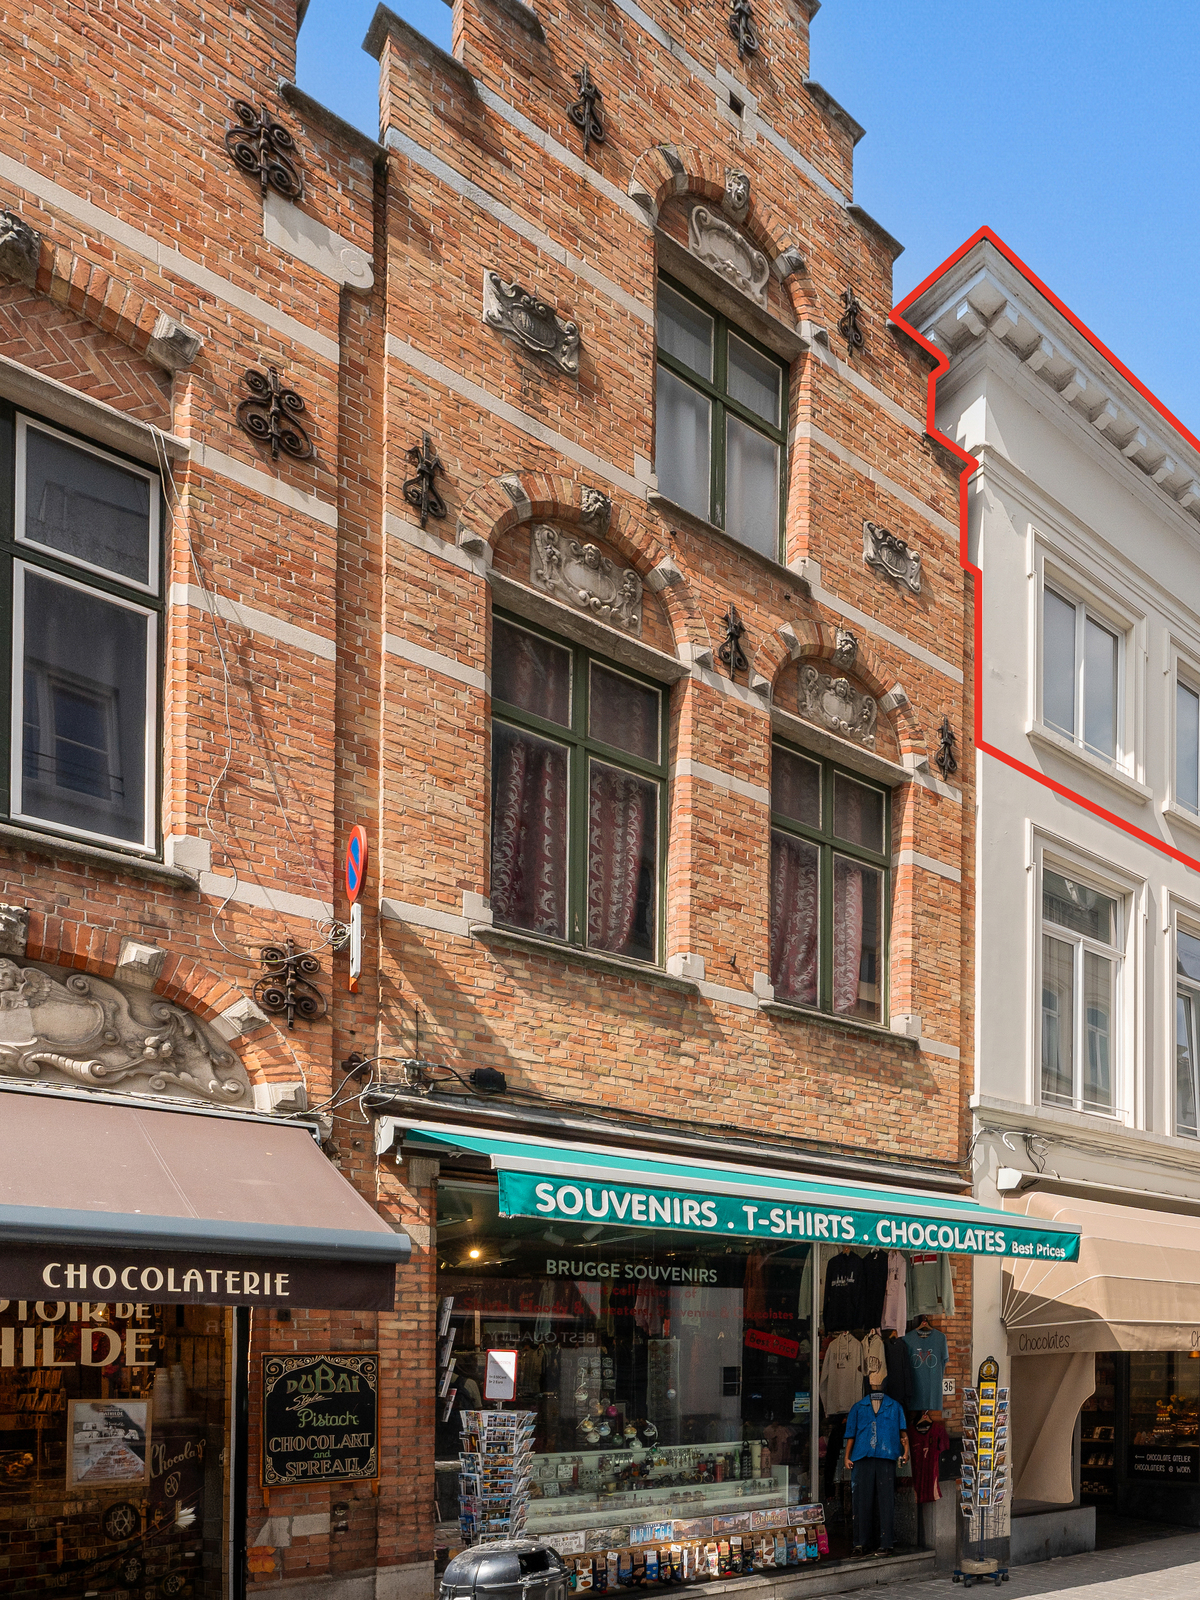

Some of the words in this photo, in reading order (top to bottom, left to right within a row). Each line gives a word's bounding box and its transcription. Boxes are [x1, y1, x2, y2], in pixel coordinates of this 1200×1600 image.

[535, 1183, 718, 1228] SOUVENIRS
[742, 1205, 855, 1240] T-SHIRTS
[876, 1219, 1006, 1252] CHOCOLATES
[1011, 1242, 1034, 1255] Best
[1036, 1243, 1066, 1258] Prices
[42, 1262, 290, 1296] CHOCOLATERIE
[546, 1259, 620, 1278] BRUGGE
[624, 1264, 718, 1283] SOUVENIRS
[0, 1299, 108, 1323] TOIR
[115, 1302, 152, 1320] DE
[520, 1299, 569, 1316] Hoody
[574, 1301, 585, 1314] &
[749, 1332, 770, 1348] Best
[772, 1338, 796, 1354] Price
[1018, 1333, 1071, 1352] Chocolates
[943, 1381, 953, 1392] 36
[313, 1450, 332, 1459] and
[923, 1447, 929, 1458] 7
[1146, 1453, 1172, 1462] CHOCOLATE
[1172, 1454, 1191, 1463] ATELIER
[755, 1514, 782, 1525] BRUGGE
